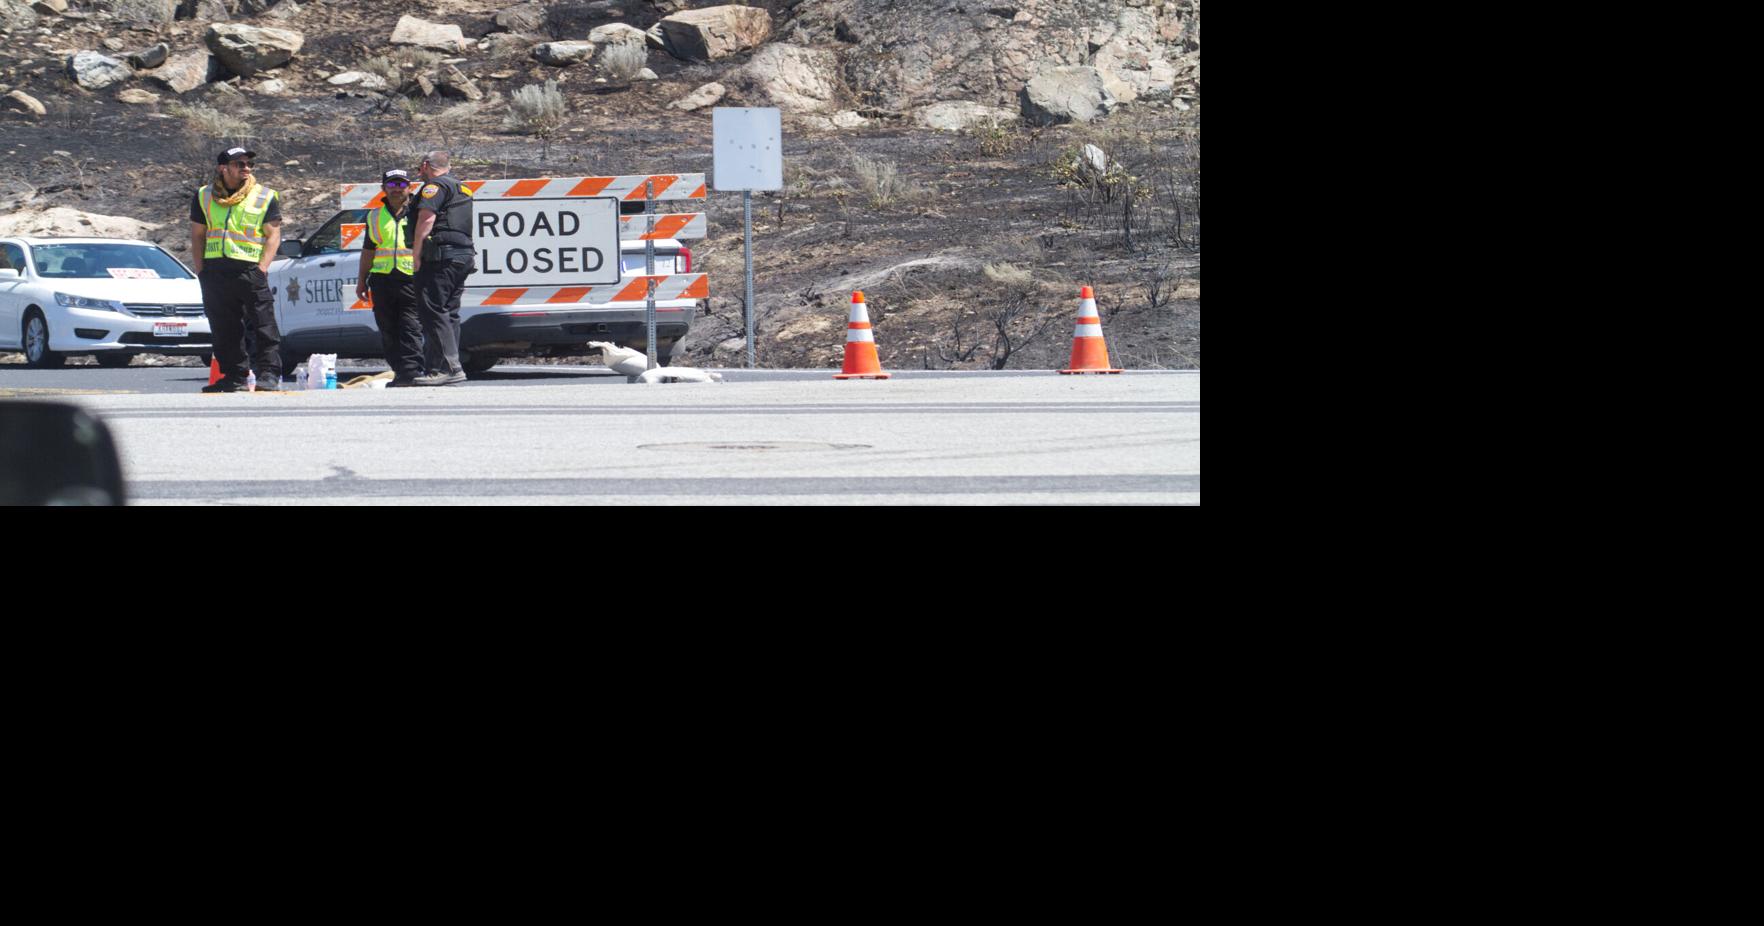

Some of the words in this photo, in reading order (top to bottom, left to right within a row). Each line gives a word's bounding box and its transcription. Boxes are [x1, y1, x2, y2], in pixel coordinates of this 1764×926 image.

[478, 211, 580, 237] ROAD
[472, 247, 604, 274] LOSED
[305, 279, 363, 306] SHER
